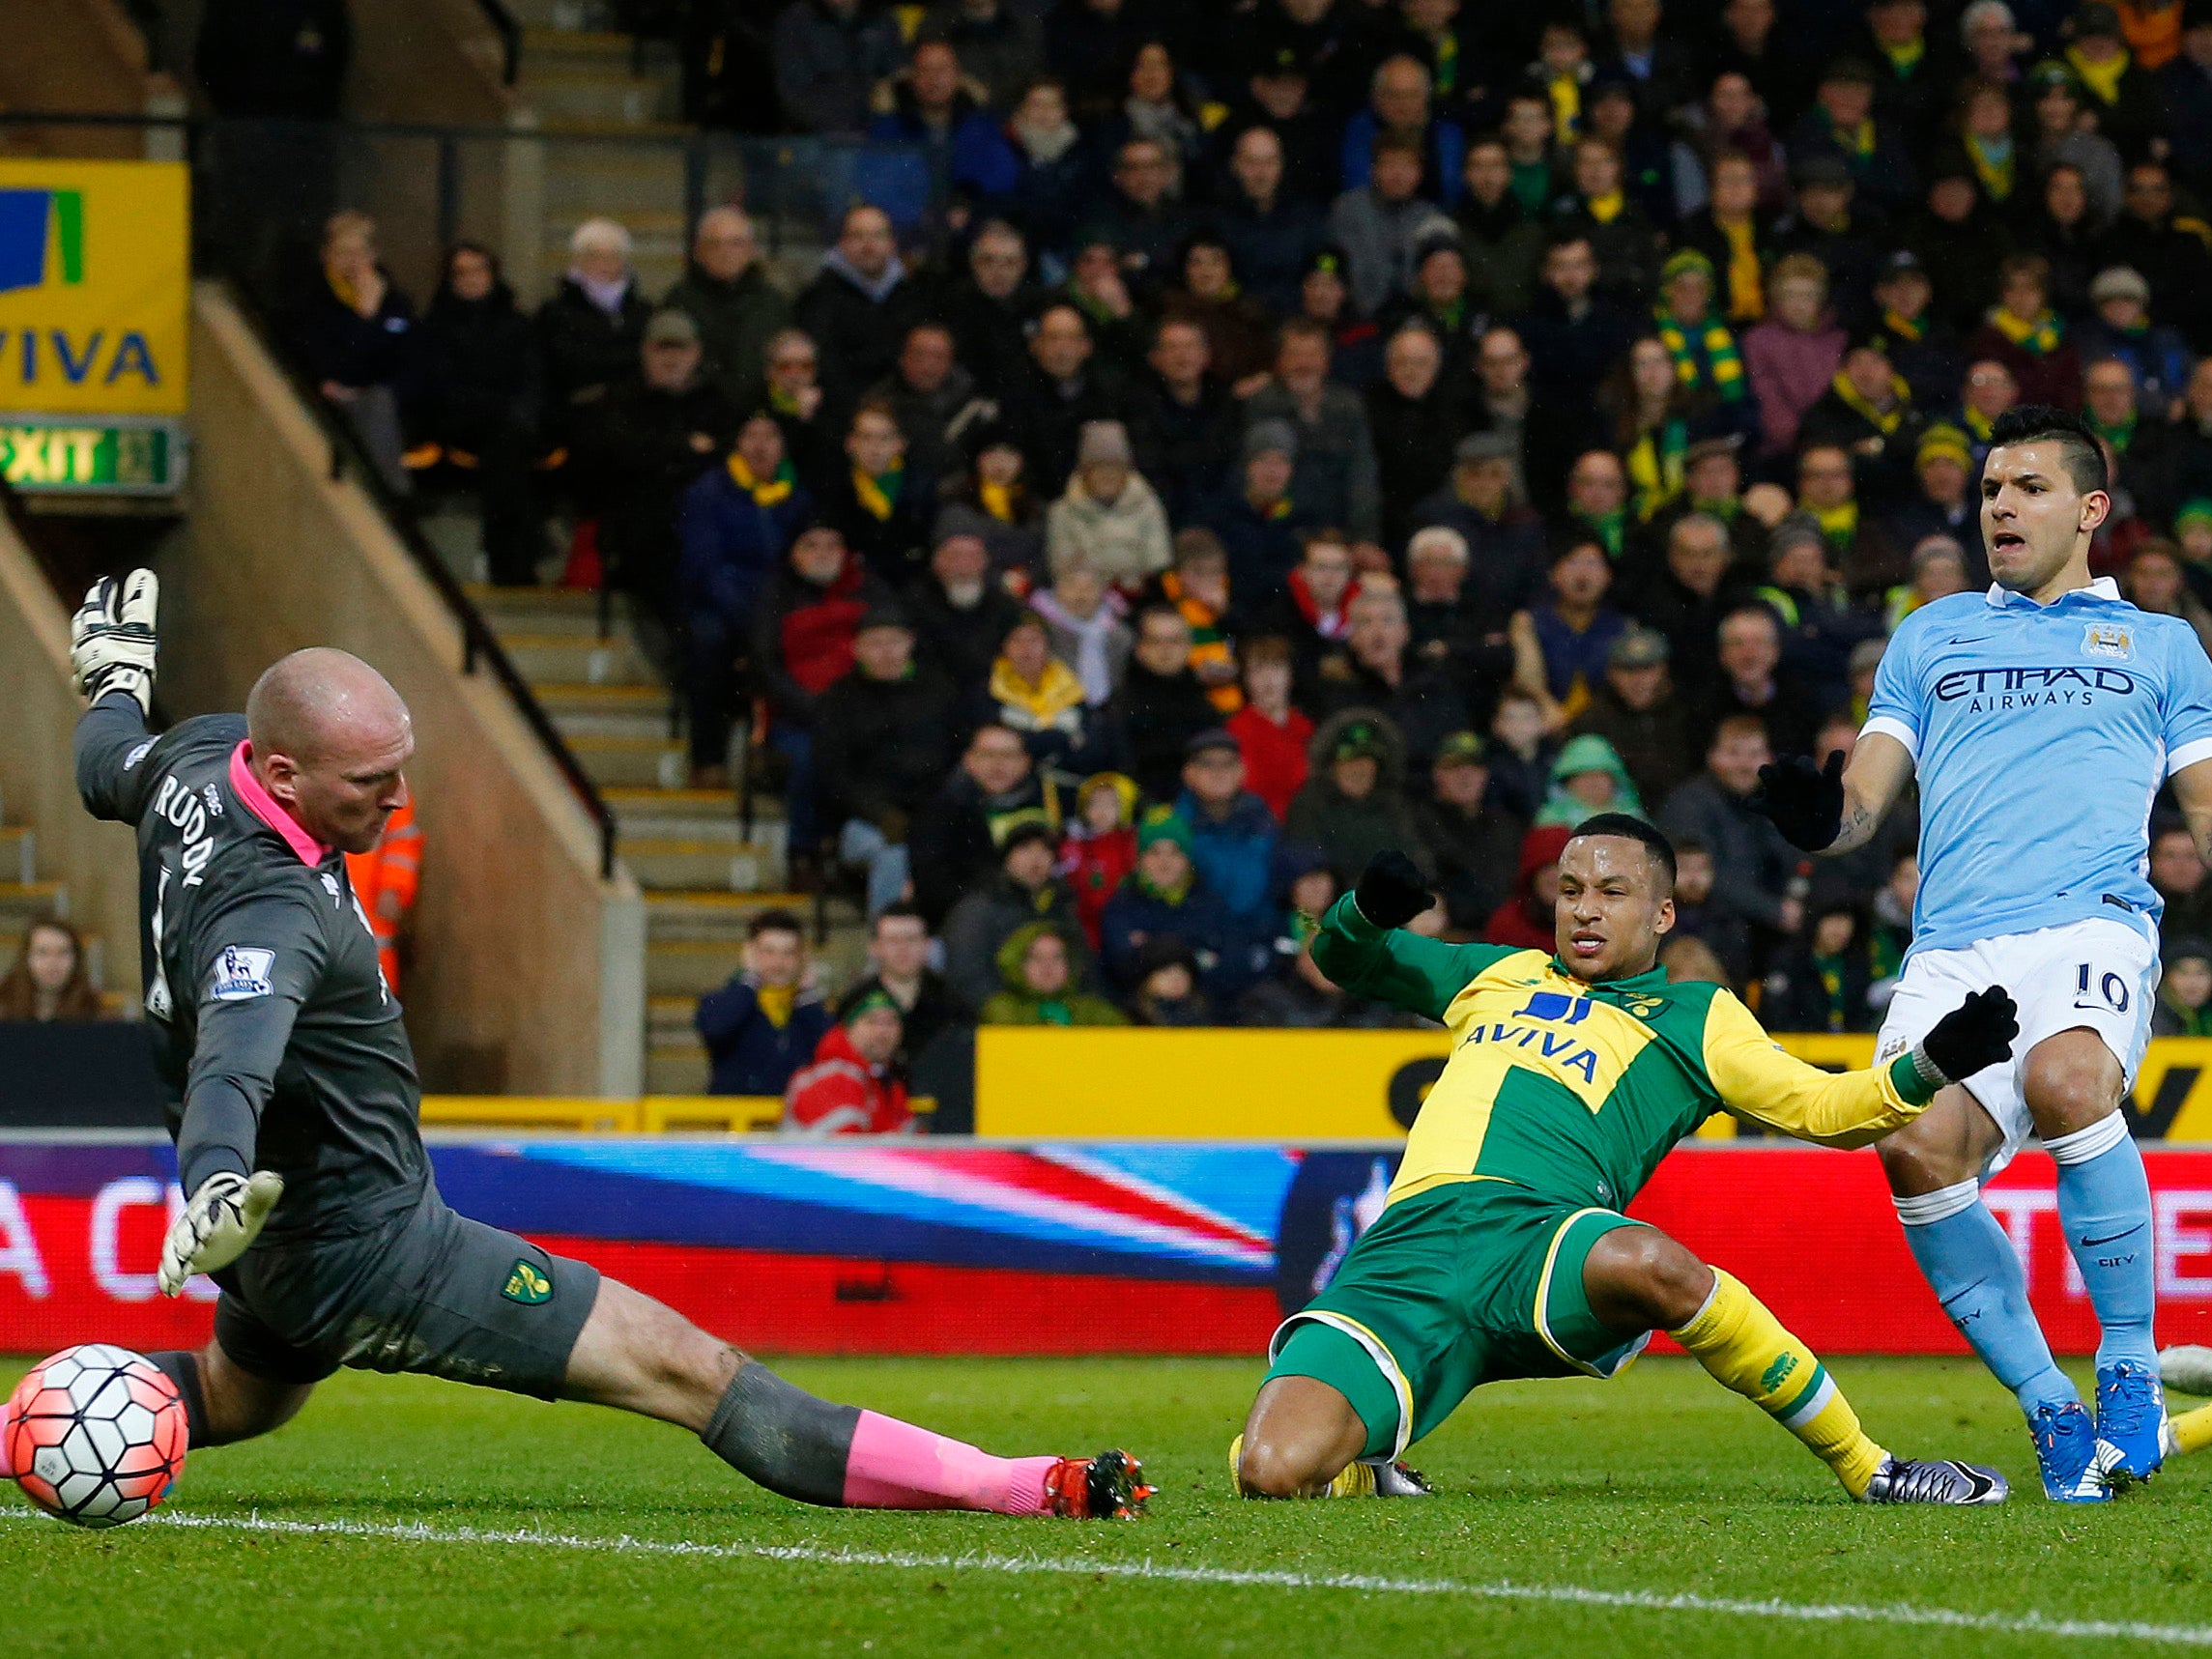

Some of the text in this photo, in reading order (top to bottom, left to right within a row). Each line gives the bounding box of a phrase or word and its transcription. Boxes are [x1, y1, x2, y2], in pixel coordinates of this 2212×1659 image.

[0, 330, 159, 384] IVA
[1936, 668, 2135, 701] ETIHAD
[1968, 691, 2093, 714] AIRWAYS
[155, 774, 214, 888] RUDDY
[2077, 963, 2129, 1013] 10
[1458, 1023, 1597, 1084] AVIVA
[2099, 1254, 2134, 1267] CITY
